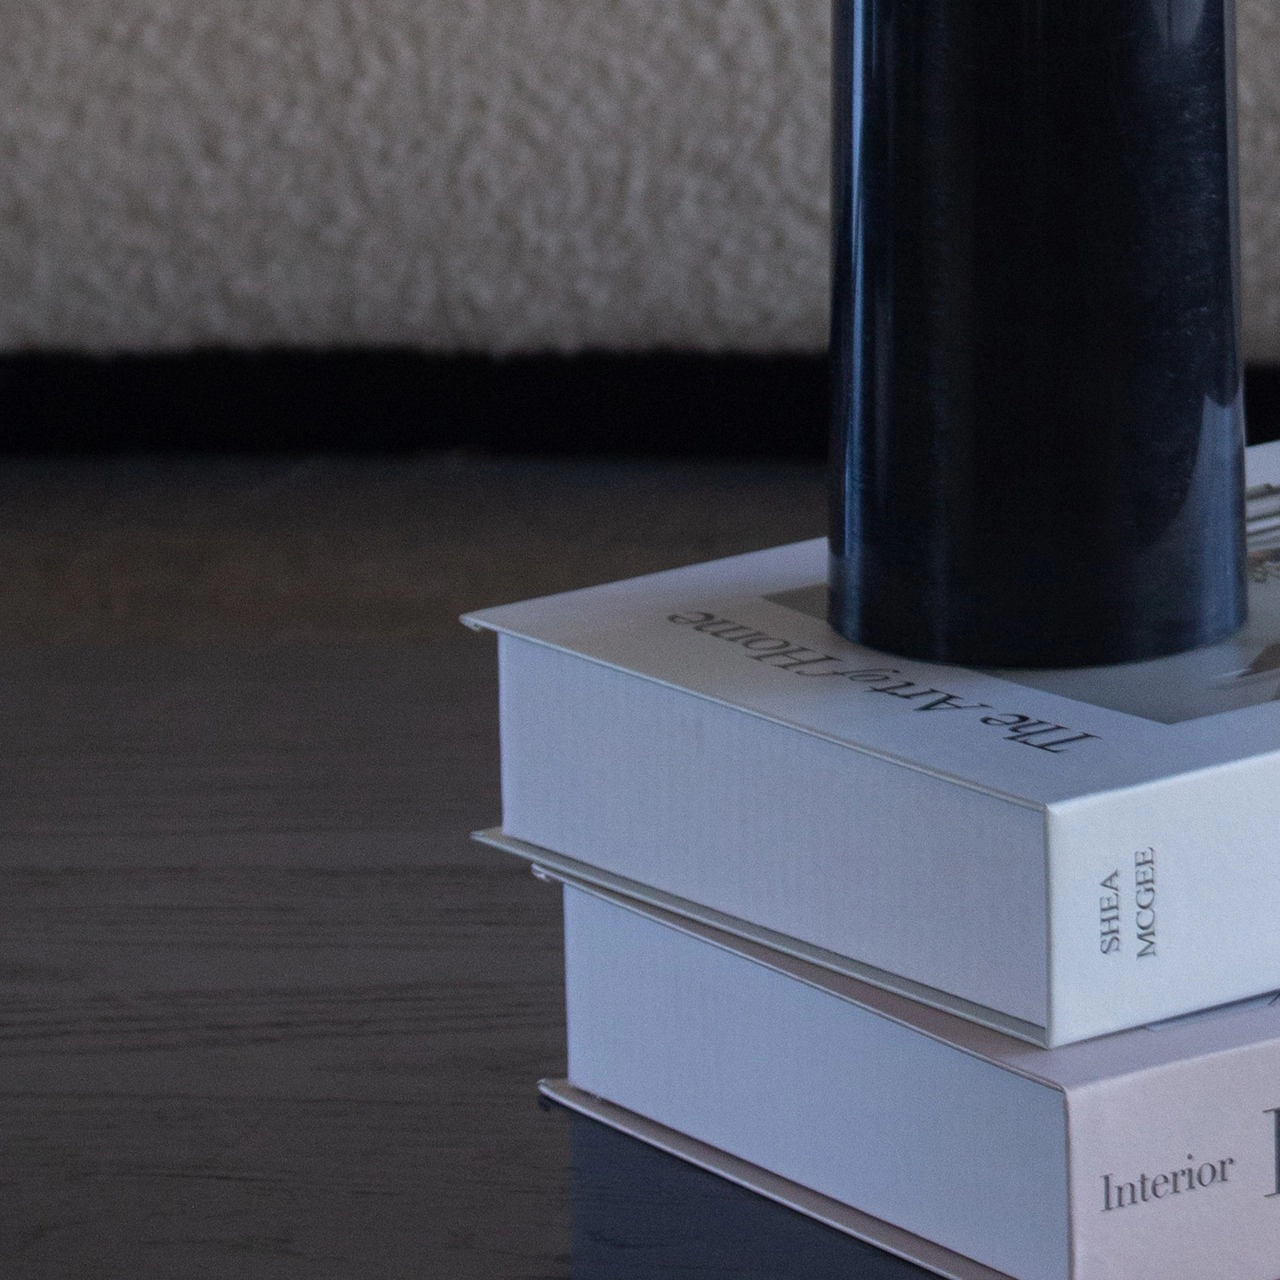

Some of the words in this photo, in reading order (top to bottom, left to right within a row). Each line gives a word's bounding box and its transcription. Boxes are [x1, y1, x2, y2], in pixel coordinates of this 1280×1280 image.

[666, 610, 844, 673] Home
[863, 680, 993, 712] Art
[979, 712, 1102, 754] The
[1099, 869, 1121, 955] SHEA
[1134, 846, 1157, 960] MCGEE
[1100, 1152, 1236, 1213] Interior
